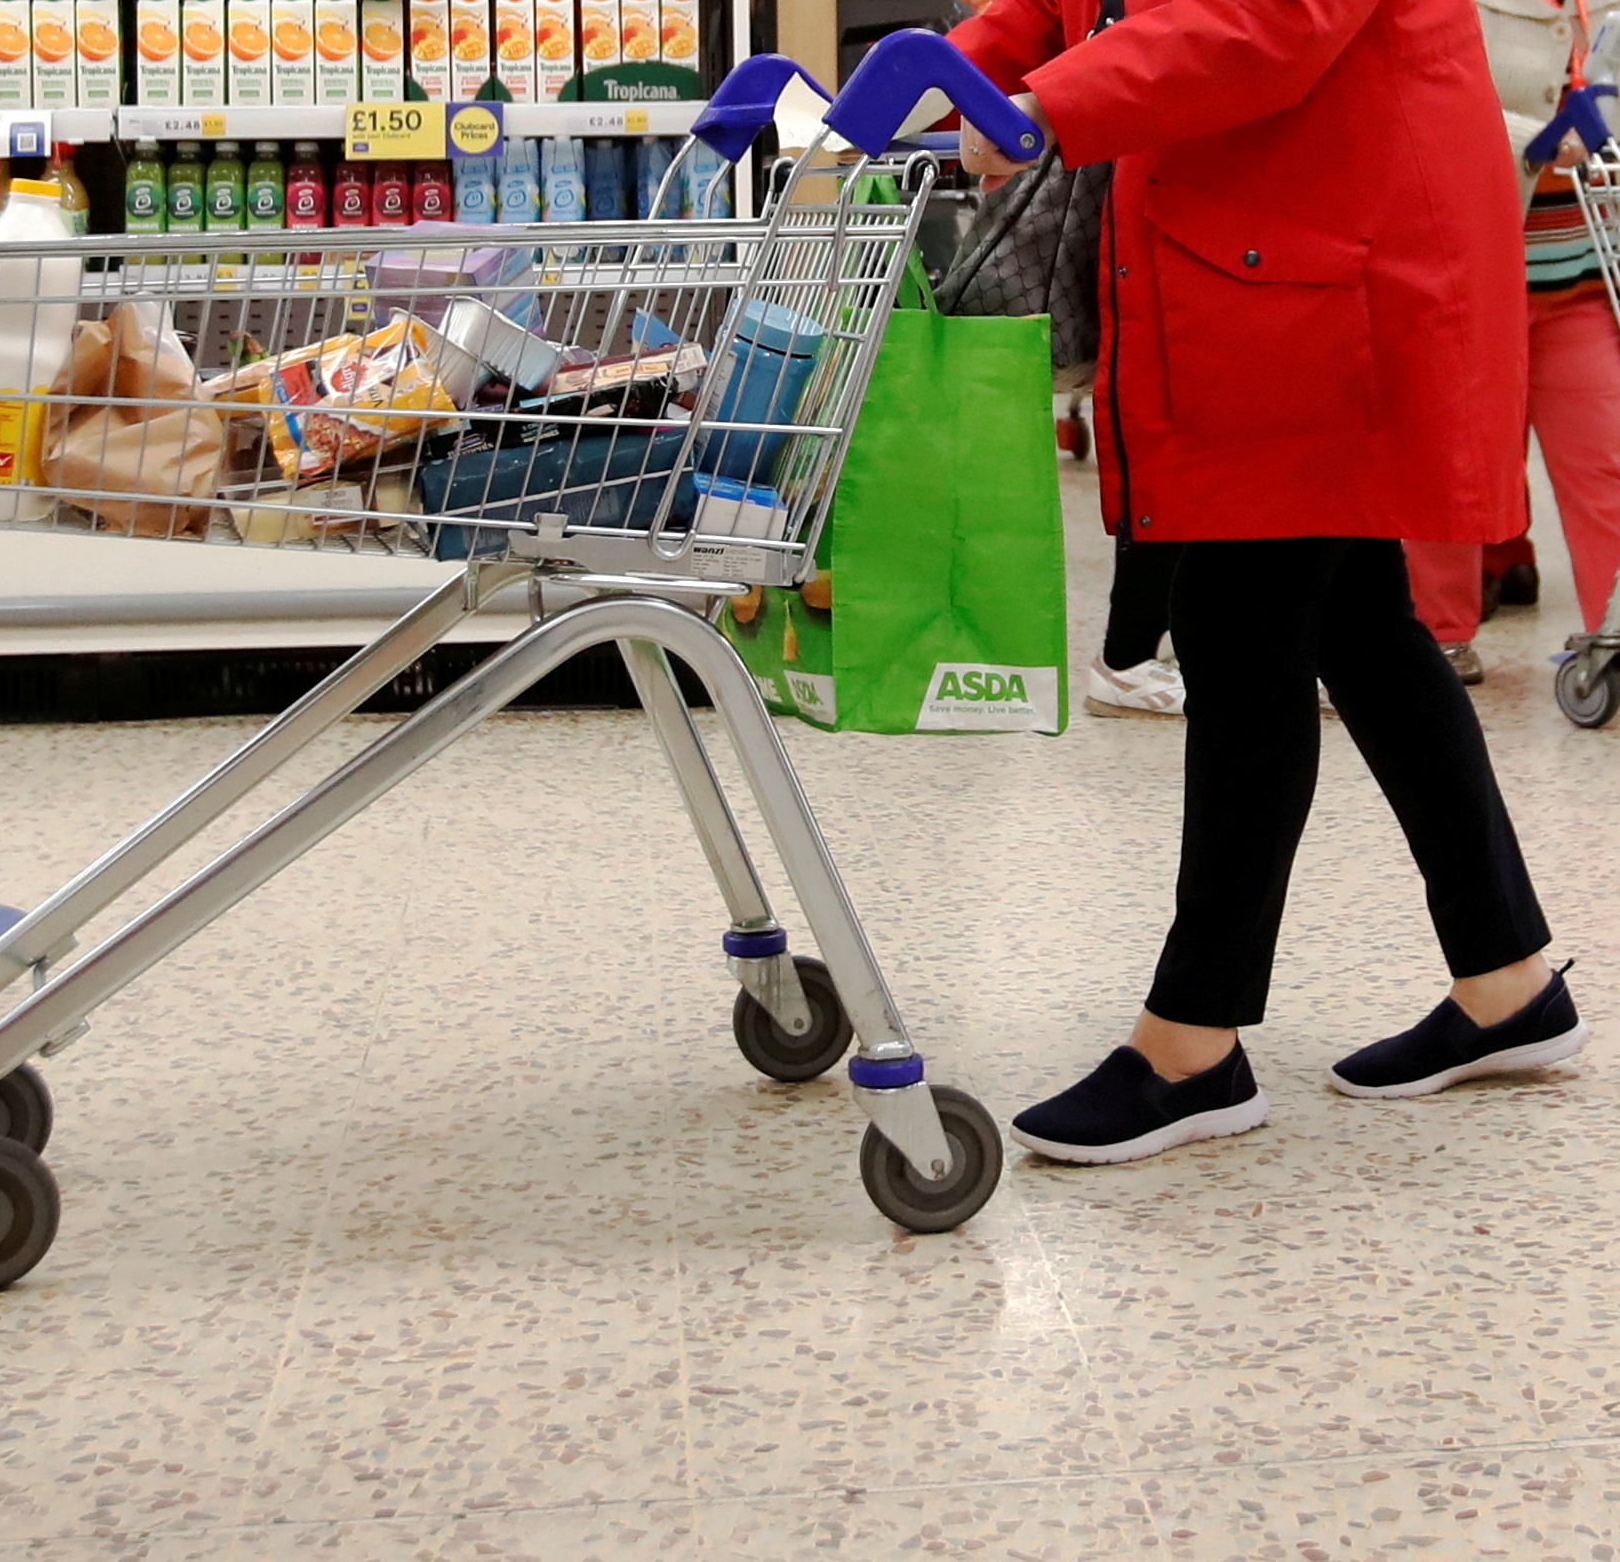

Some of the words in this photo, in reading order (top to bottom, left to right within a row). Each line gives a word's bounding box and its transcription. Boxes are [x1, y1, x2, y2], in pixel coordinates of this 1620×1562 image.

[603, 79, 677, 103] Tropicana
[165, 119, 201, 131] £2.48
[351, 110, 423, 132] £1.50
[453, 121, 496, 132] Clubcard
[588, 117, 624, 127] £2.48
[460, 131, 489, 140] Prices
[693, 546, 725, 556] wanzl
[936, 671, 1029, 703] ASDA
[929, 704, 951, 714] Save
[987, 705, 1007, 715] Live
